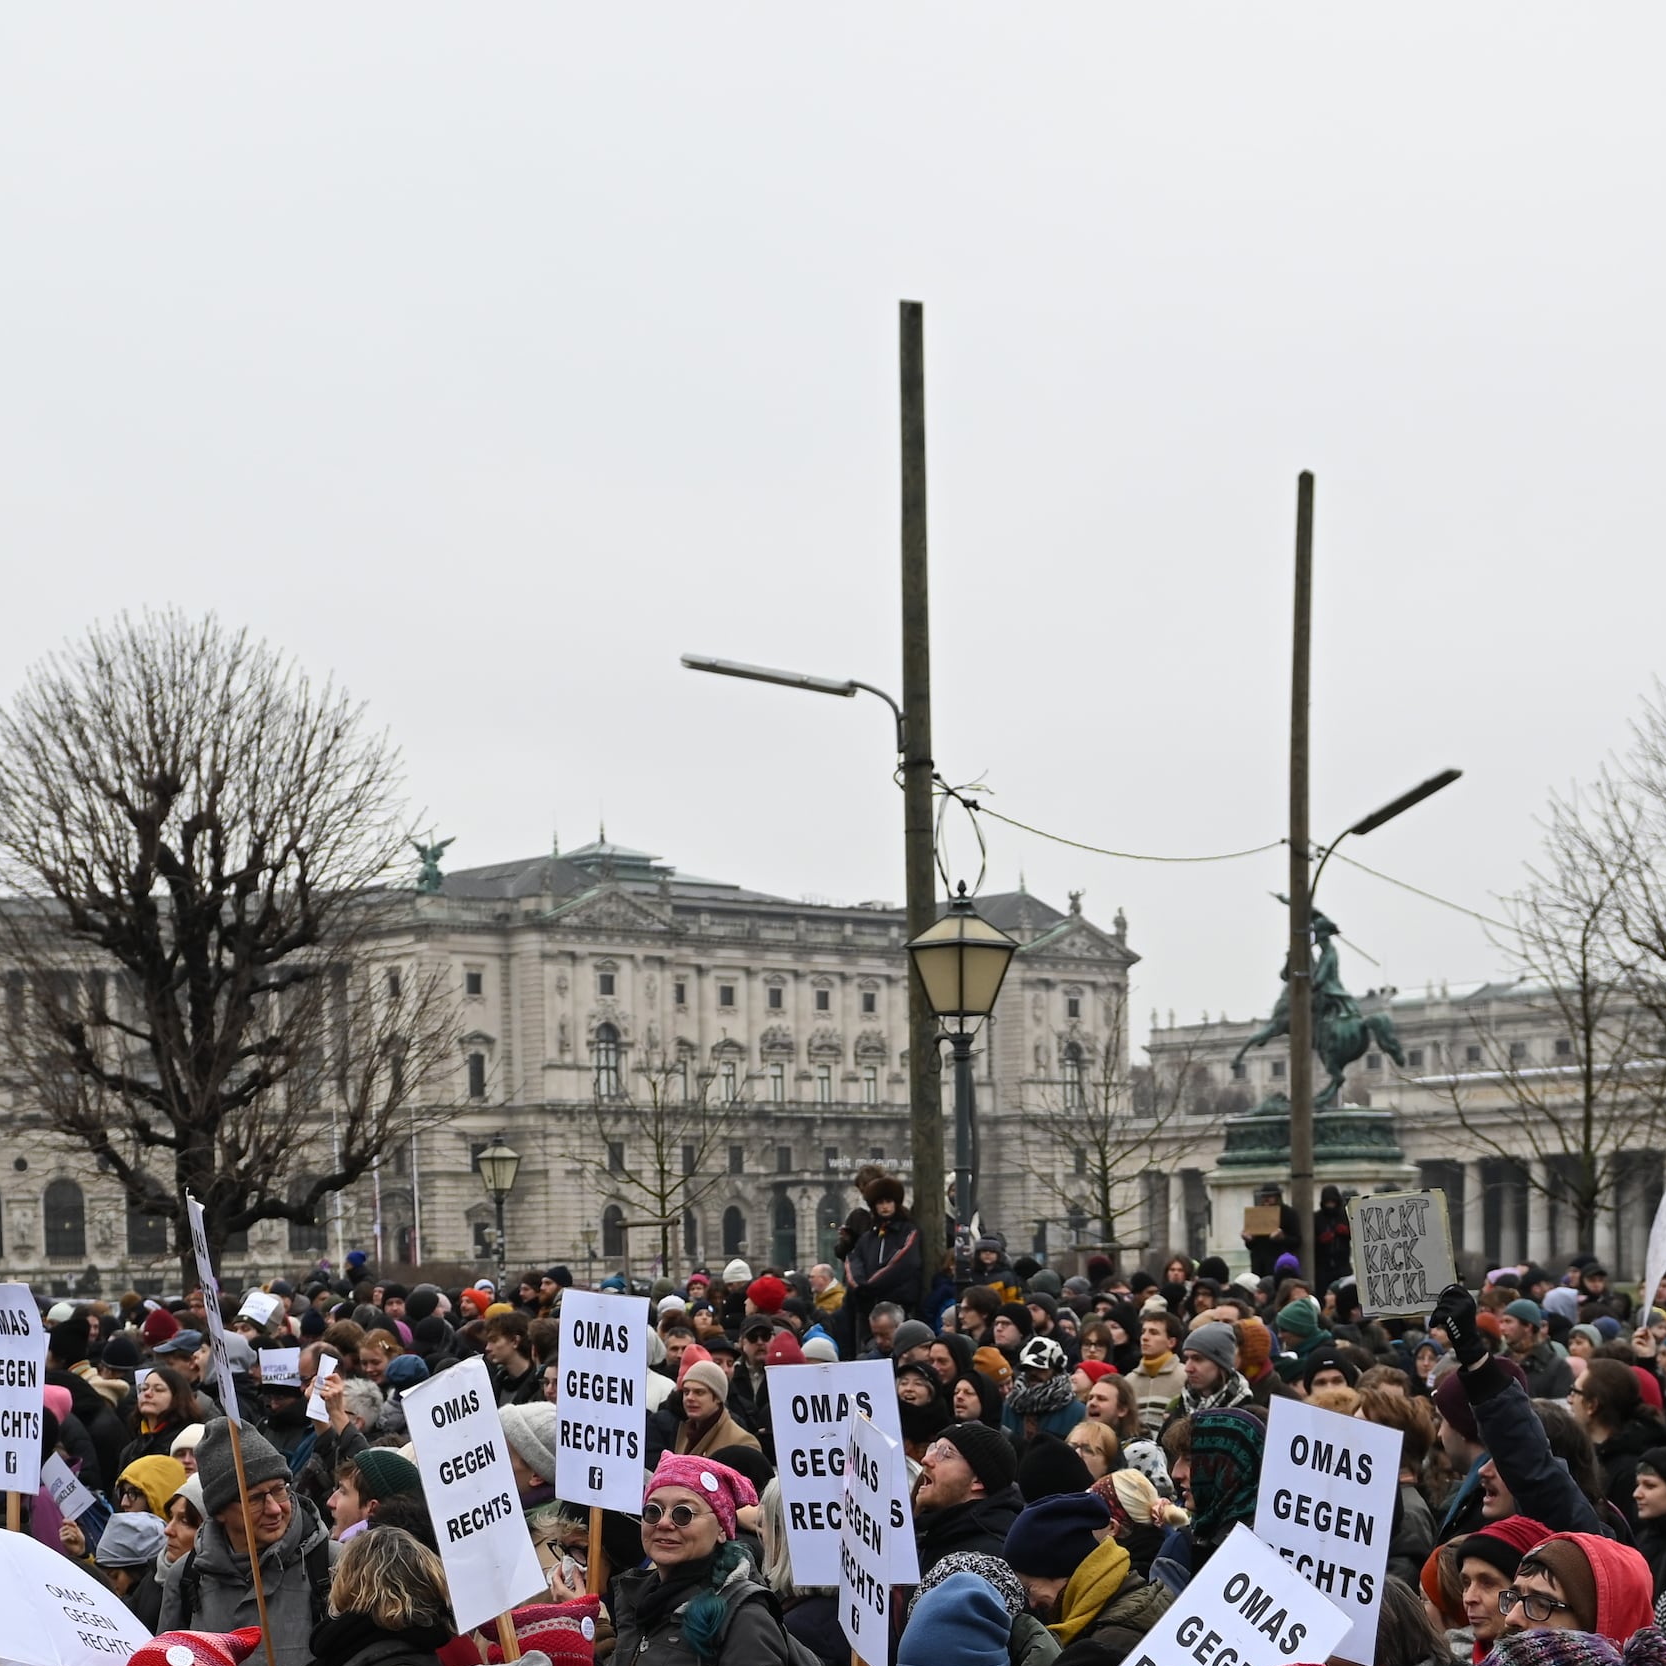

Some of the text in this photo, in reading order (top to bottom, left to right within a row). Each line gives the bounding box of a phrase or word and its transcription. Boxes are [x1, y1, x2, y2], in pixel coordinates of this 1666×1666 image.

[1360, 1199, 1429, 1242] KICKT
[1363, 1238, 1423, 1274] KACK
[1367, 1270, 1440, 1308] KICKL
[573, 1319, 629, 1353] OMAS
[566, 1371, 633, 1405] GEGEN
[431, 1389, 479, 1428] OMAS
[560, 1424, 639, 1459] RECHTS
[1290, 1435, 1374, 1486] OMAS
[439, 1441, 496, 1485] GEGEN
[790, 1447, 845, 1477] GEG
[849, 1436, 879, 1493] OMAS
[446, 1492, 513, 1543] RECHTS
[790, 1499, 904, 1530] RECS
[844, 1488, 881, 1556] GEGEN
[1274, 1489, 1374, 1547] GEGEN
[44, 1583, 96, 1607] OMAS
[841, 1538, 884, 1616] RECHTS
[62, 1605, 119, 1632] GEGEN
[1223, 1573, 1308, 1656] OMAS
[78, 1629, 134, 1657] RECHTS
